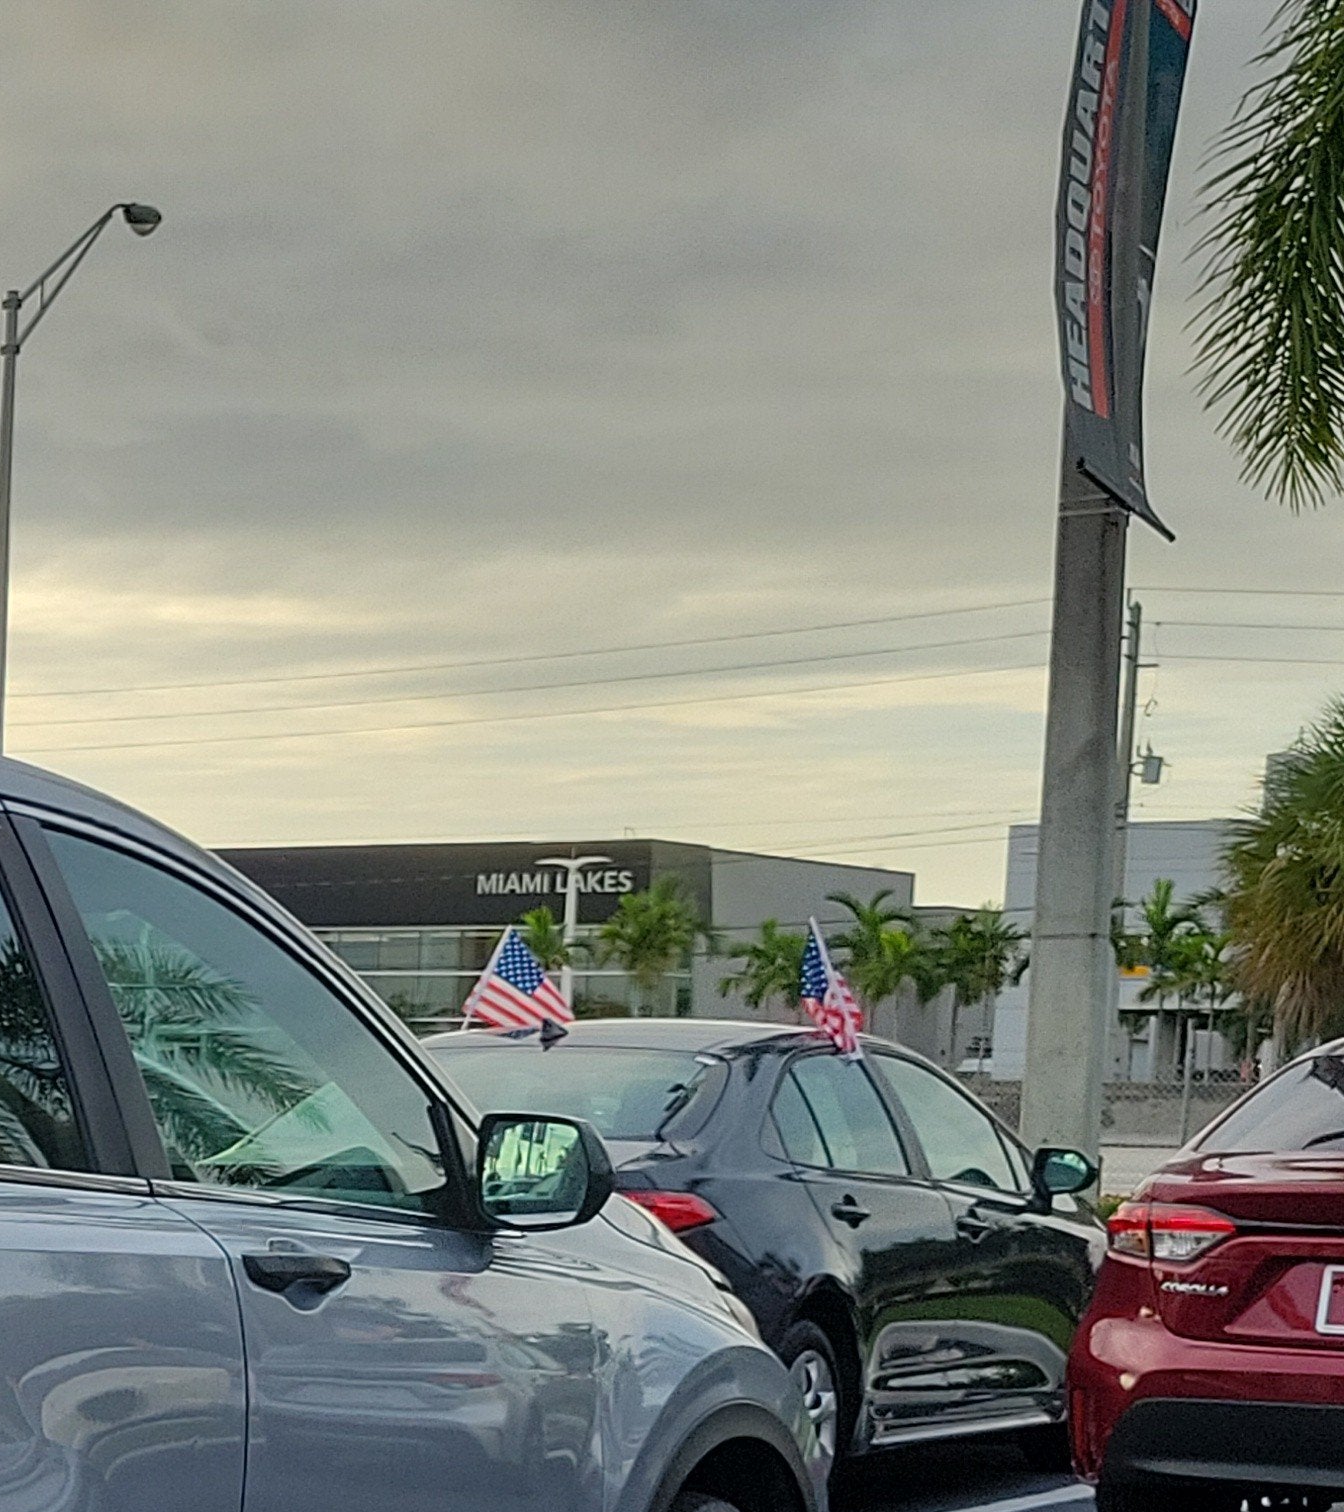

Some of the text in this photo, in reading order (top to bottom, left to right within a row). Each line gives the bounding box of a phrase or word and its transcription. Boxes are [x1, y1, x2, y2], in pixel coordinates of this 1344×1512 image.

[1062, 0, 1111, 413] HEADQUART
[476, 870, 633, 895] MIAMI LAKES
